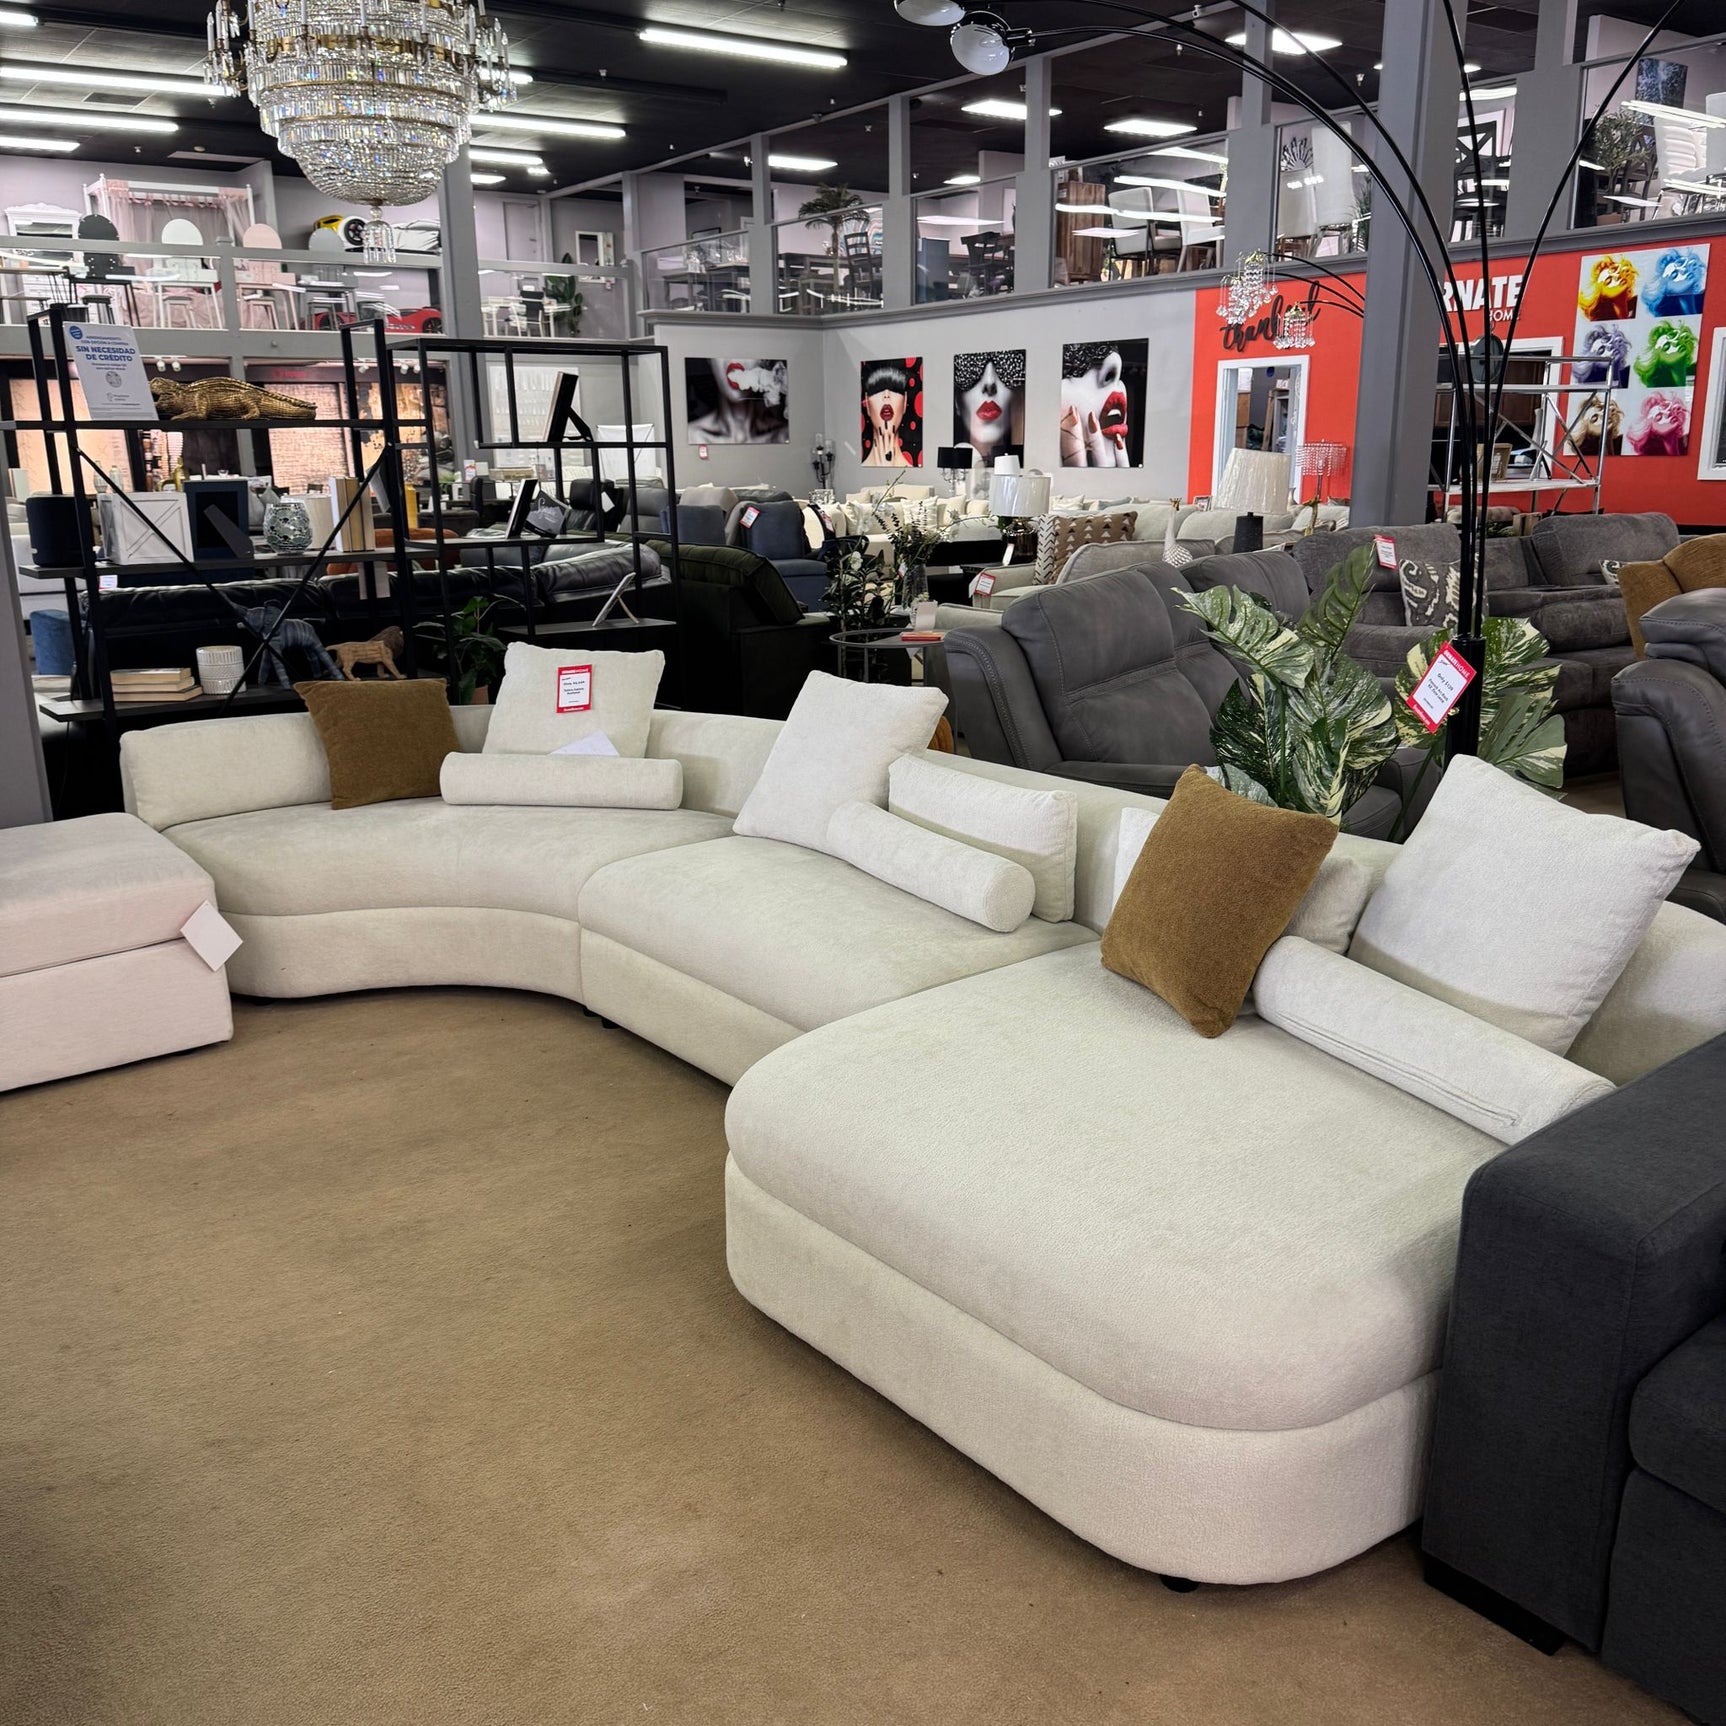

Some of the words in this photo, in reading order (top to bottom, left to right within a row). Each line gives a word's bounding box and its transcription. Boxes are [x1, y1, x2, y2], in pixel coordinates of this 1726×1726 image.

[1443, 275, 1523, 312] RNATE
[1489, 308, 1520, 322] OM
[91, 346, 136, 355] NECESIDAD
